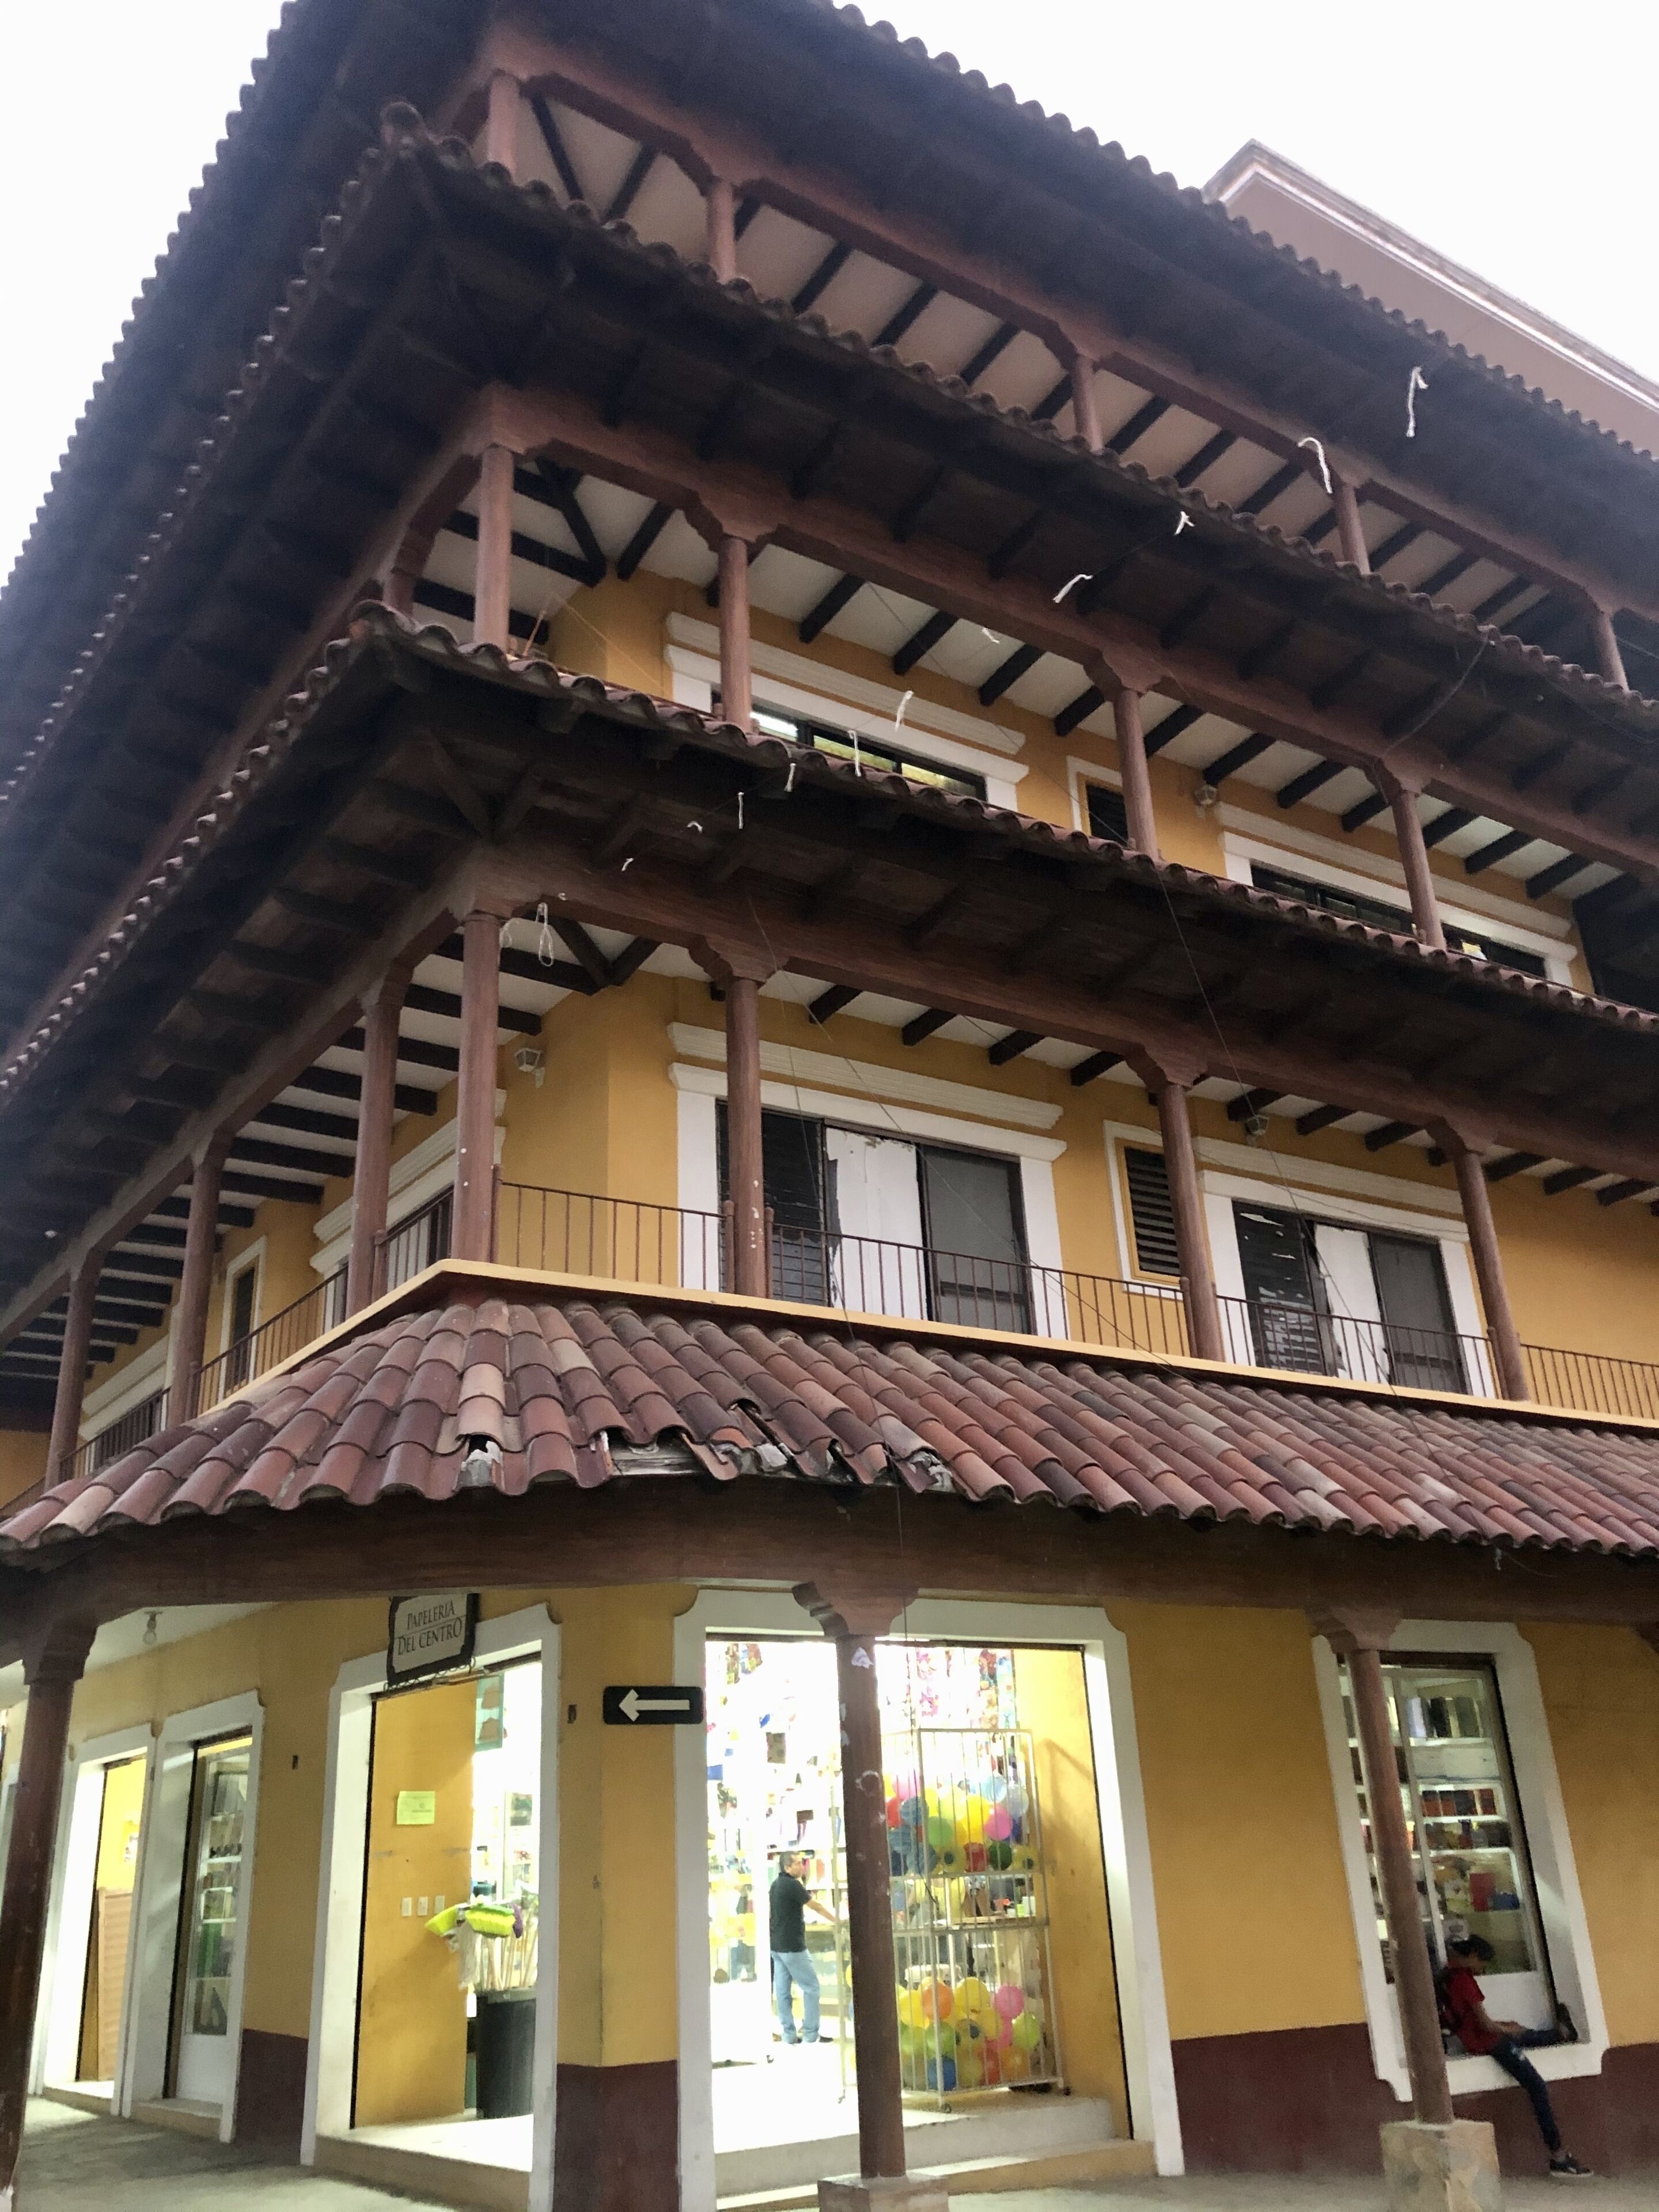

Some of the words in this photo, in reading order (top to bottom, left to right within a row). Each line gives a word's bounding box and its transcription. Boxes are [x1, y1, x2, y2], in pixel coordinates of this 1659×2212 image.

[407, 1600, 455, 1630] PAPELERIA
[398, 1635, 415, 1656] DEL
[419, 1617, 462, 1648] CENTRO
